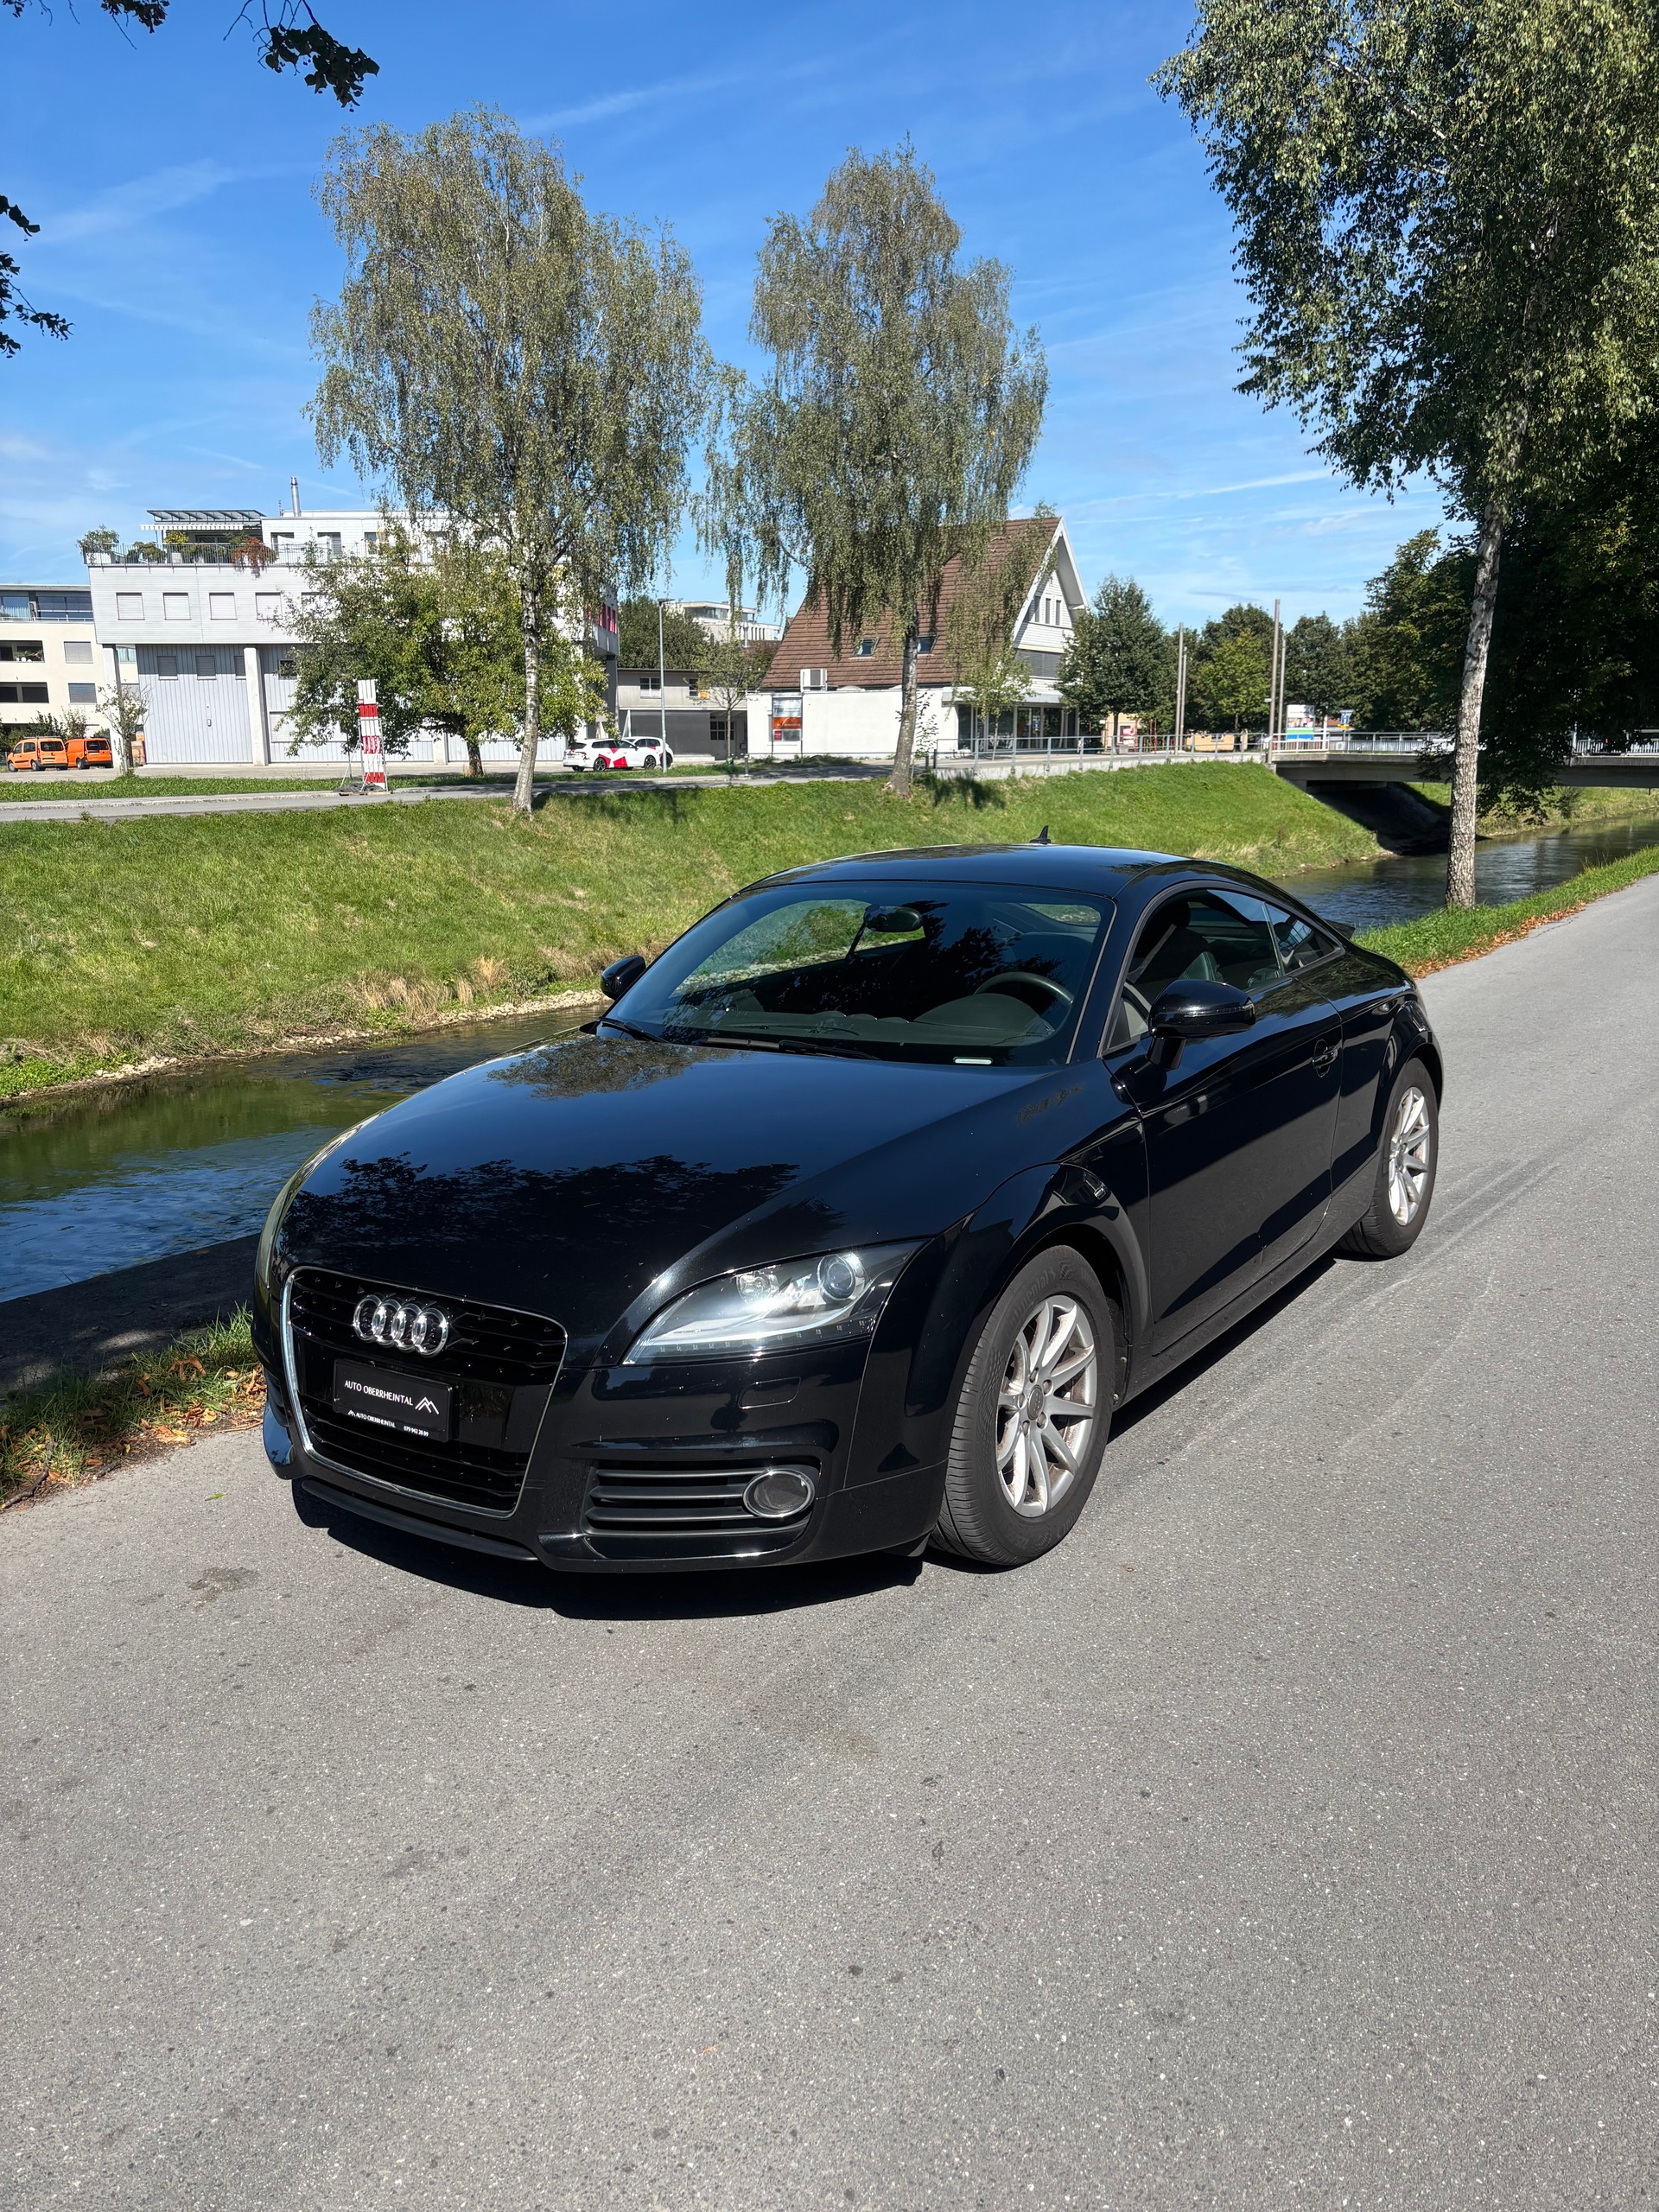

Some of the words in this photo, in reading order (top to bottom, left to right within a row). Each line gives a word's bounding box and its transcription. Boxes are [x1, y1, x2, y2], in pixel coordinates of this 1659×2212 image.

[345, 1380, 361, 1392] AUTO
[364, 1386, 414, 1405] OBERRHEINTAL
[367, 1415, 396, 1427] OBERRHEINTAL
